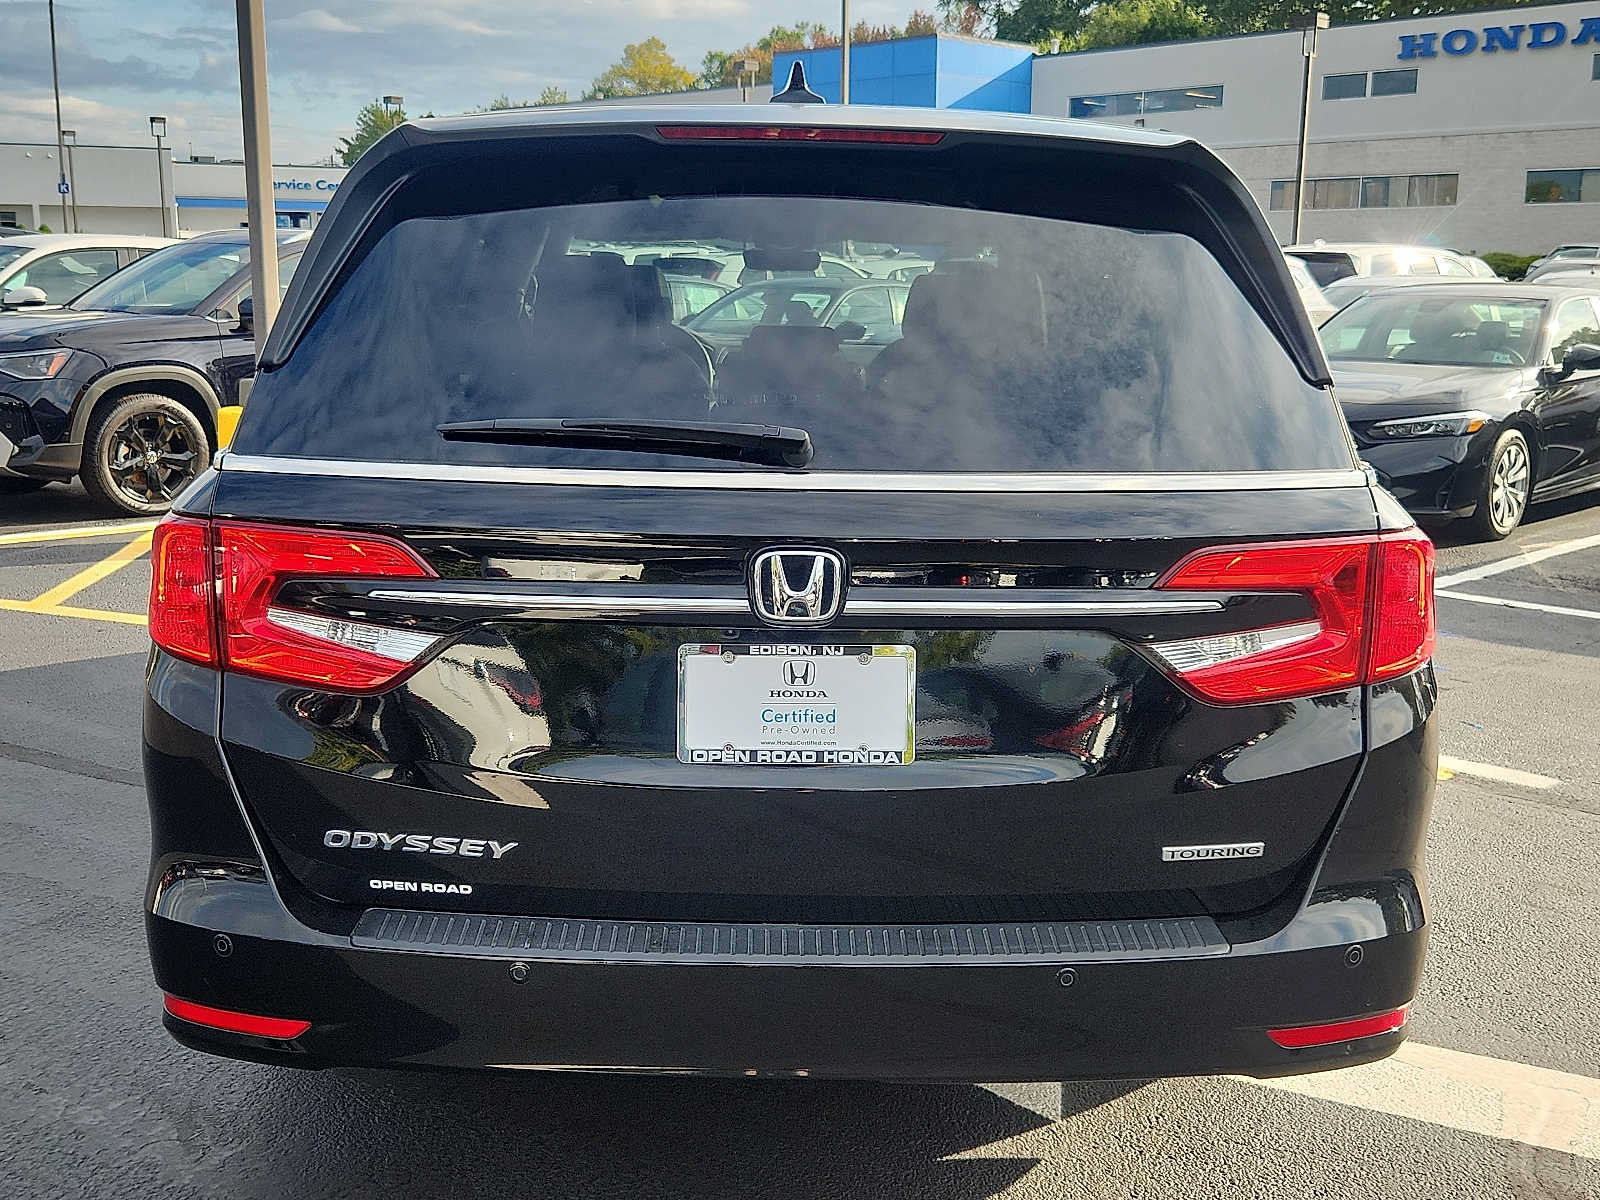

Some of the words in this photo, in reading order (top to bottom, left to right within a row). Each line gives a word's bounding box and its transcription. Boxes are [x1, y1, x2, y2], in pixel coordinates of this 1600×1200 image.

[1397, 17, 1600, 60] HONDA
[749, 645, 817, 656] EDISON,
[822, 646, 845, 656] NJ
[769, 690, 828, 698] HONDA
[761, 709, 836, 723] Certified
[762, 725, 836, 735] Pre-Owned
[692, 750, 750, 763] OPEN
[757, 751, 817, 763] ROAD
[824, 751, 902, 764] HONDA
[323, 829, 519, 859] ODYSSEY
[1167, 846, 1261, 859] TOURING
[369, 879, 418, 892] OPEN
[420, 882, 473, 894] ROAD
